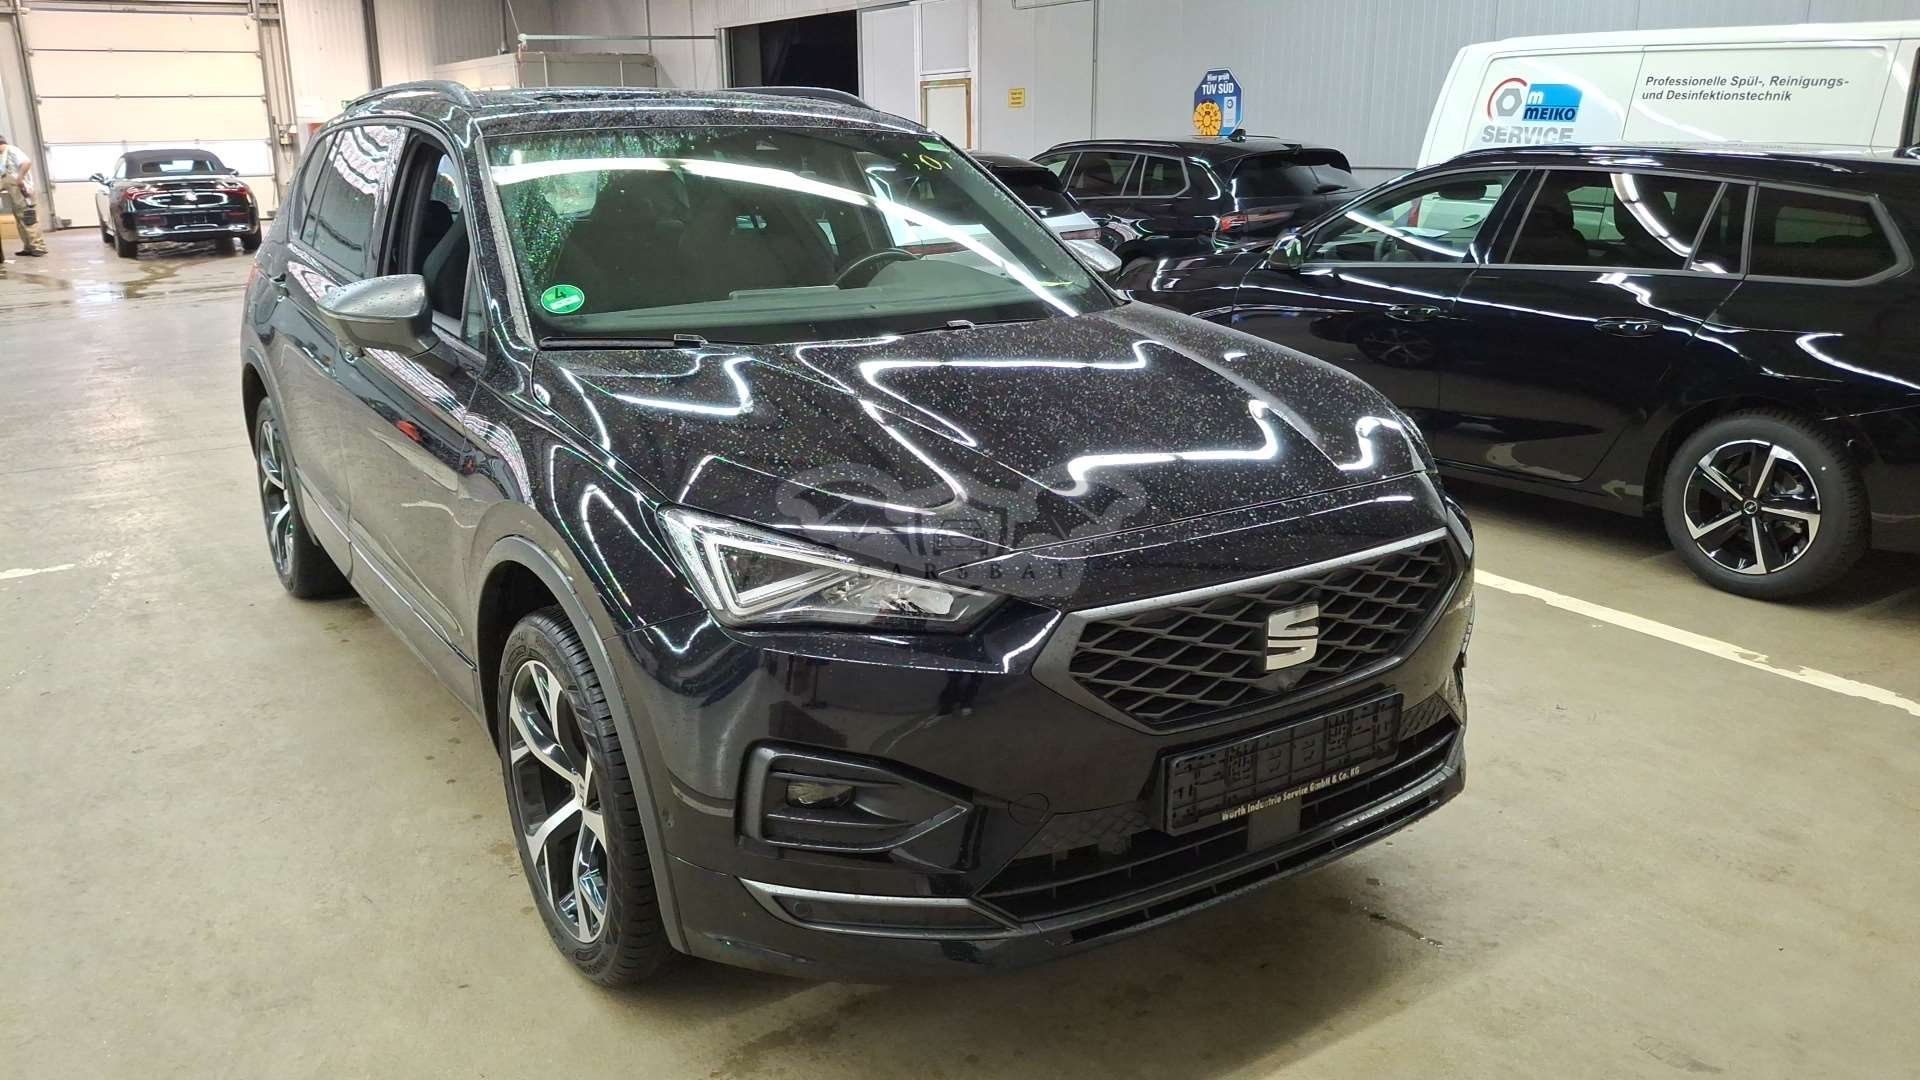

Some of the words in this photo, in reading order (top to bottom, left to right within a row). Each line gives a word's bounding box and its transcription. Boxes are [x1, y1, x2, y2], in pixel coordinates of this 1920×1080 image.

[1201, 81, 1217, 95] TÜV
[1218, 81, 1234, 94] SÜD
[1645, 76, 1727, 86] Professionelle
[1730, 75, 1765, 88] Spül-,
[1769, 75, 1850, 89] Reinigungs-
[1642, 90, 1664, 100] und
[1666, 90, 1793, 102] Desinfektionstechnik
[1523, 107, 1576, 121] MEIKO
[1482, 125, 1574, 144] SERVICE
[1282, 785, 1309, 801] Service
[1309, 777, 1331, 792] GmbH
[1338, 771, 1350, 782] Co.
[1350, 766, 1361, 778] KG
